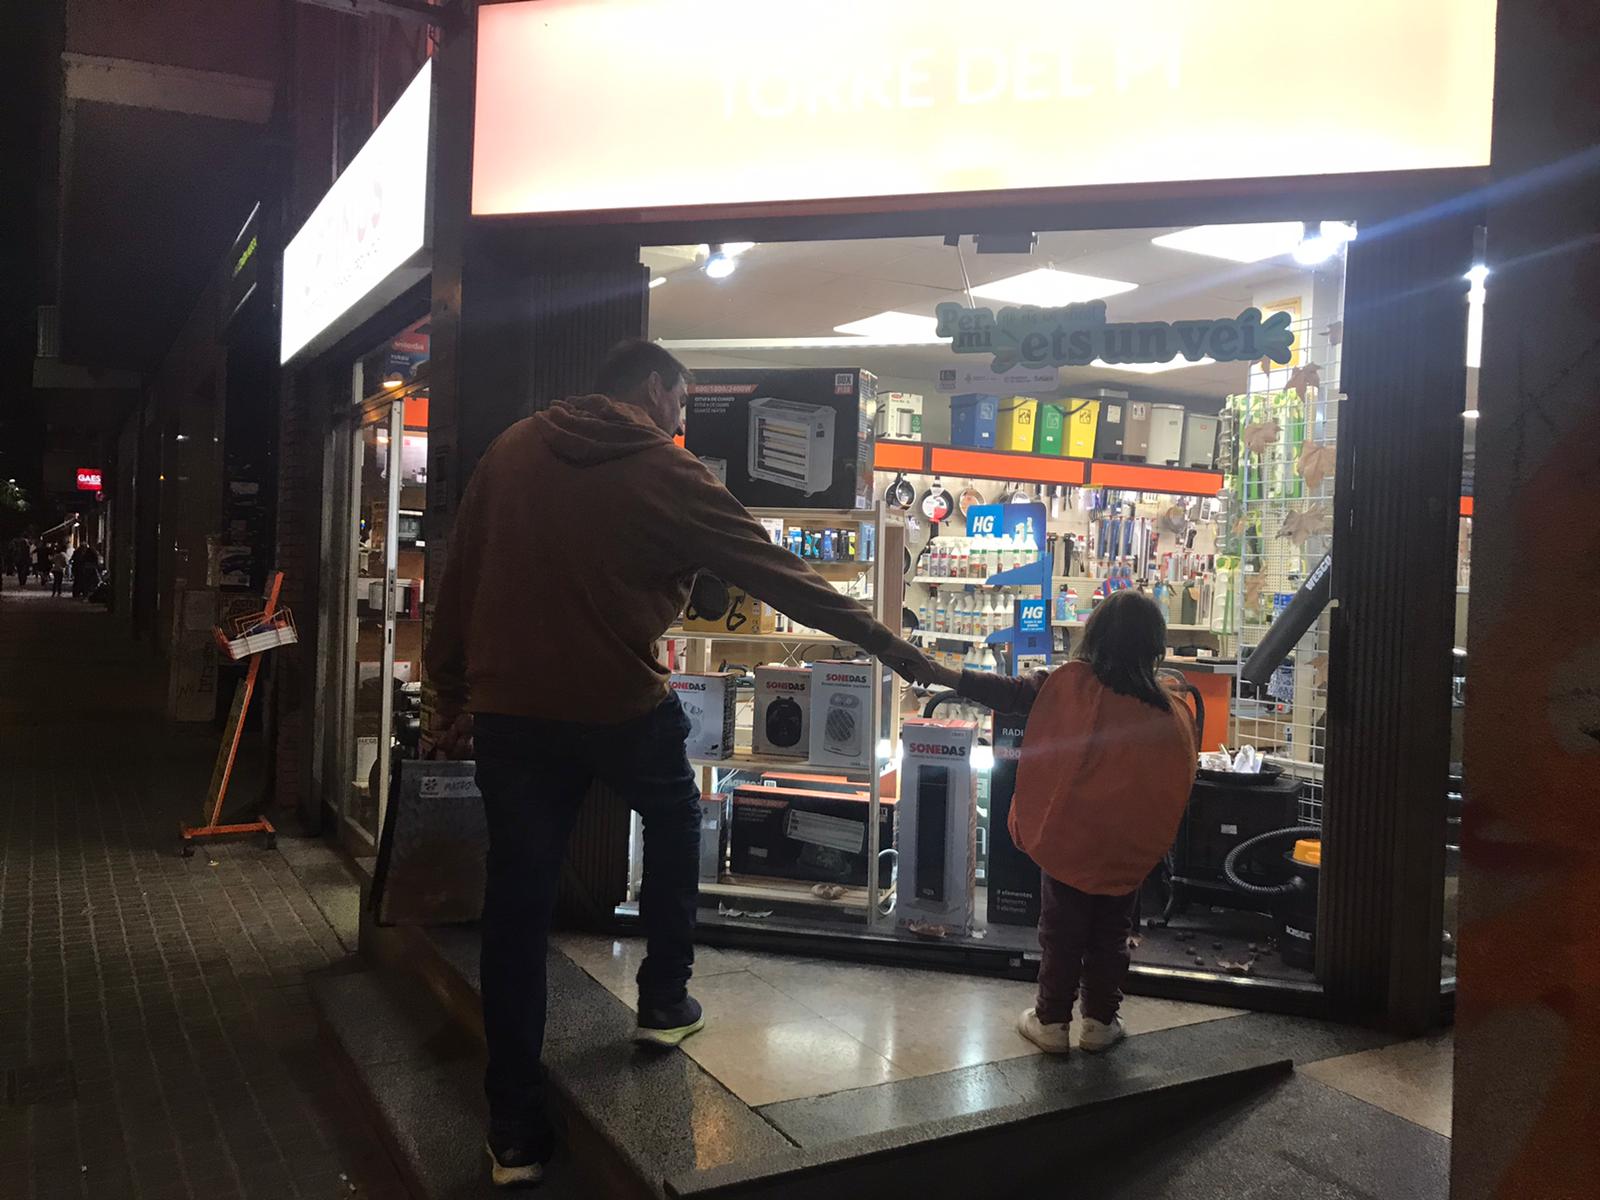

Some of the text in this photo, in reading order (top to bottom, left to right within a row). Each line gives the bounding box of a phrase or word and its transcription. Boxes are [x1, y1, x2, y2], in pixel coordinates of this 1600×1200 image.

[716, 32, 1182, 120] TORRE DEL PI
[943, 307, 986, 333] Per
[957, 325, 992, 348] mi
[1021, 323, 1092, 361] ets
[1103, 326, 1168, 359] un
[78, 474, 101, 482] GAES
[972, 515, 994, 533] HG
[1022, 606, 1043, 619] HG
[826, 673, 867, 683] SONEDAS
[669, 680, 706, 690] ONEDAS
[766, 681, 806, 691] SONEDAS
[909, 743, 966, 756] SONEDAS
